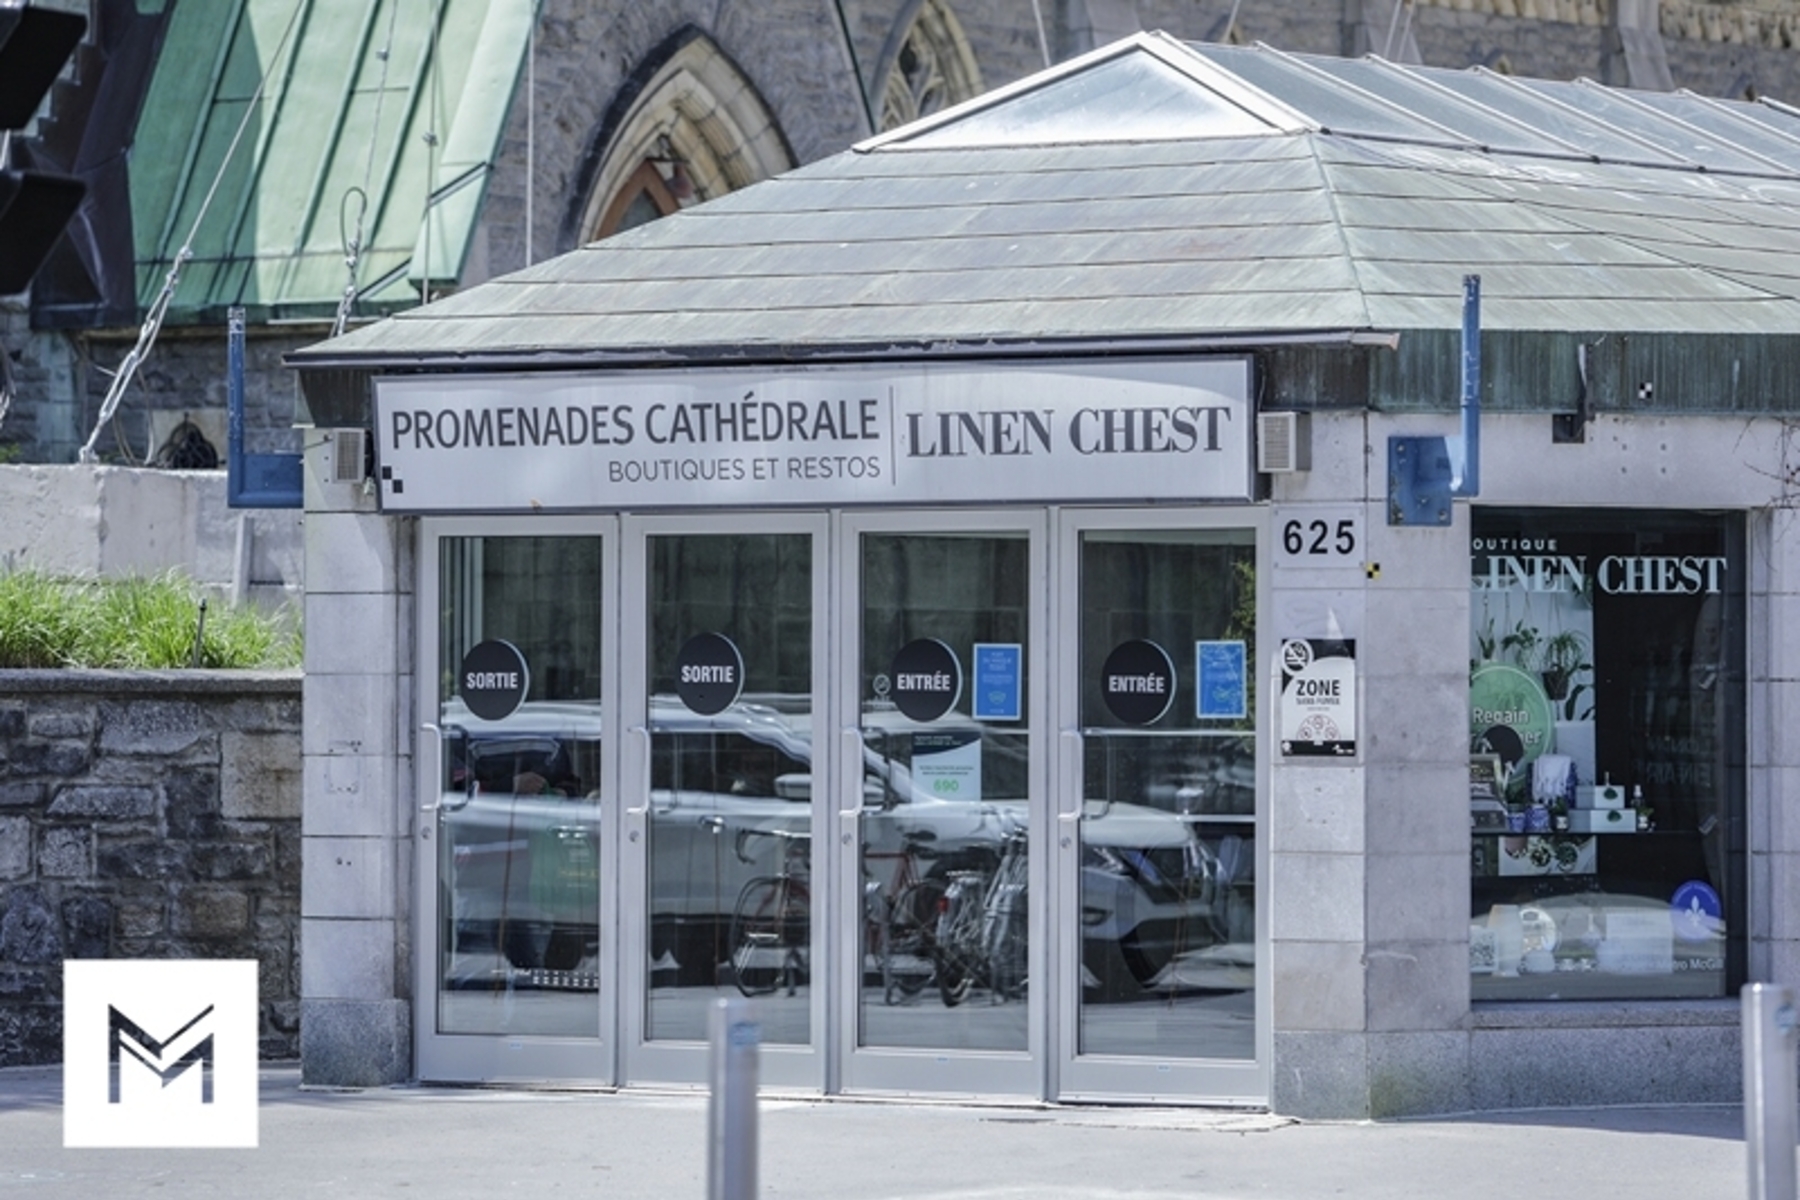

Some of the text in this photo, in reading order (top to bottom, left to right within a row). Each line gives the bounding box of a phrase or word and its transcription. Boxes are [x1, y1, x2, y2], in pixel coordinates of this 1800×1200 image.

[393, 391, 880, 449] PROMENADES CATHÉDRALE
[905, 406, 1232, 458] LINEN CHEST
[608, 457, 880, 483] BOUTIQUES ET RESTOS
[1283, 518, 1355, 555] 625
[1472, 538, 1558, 551] OUTIQUE
[1597, 555, 1728, 594] CHEST
[466, 672, 518, 690] SORTIE
[681, 665, 734, 684] SORTIE
[896, 670, 951, 691] ENTRÉE
[1108, 672, 1165, 693] ENTRÉE
[1296, 679, 1340, 696] ZONE
